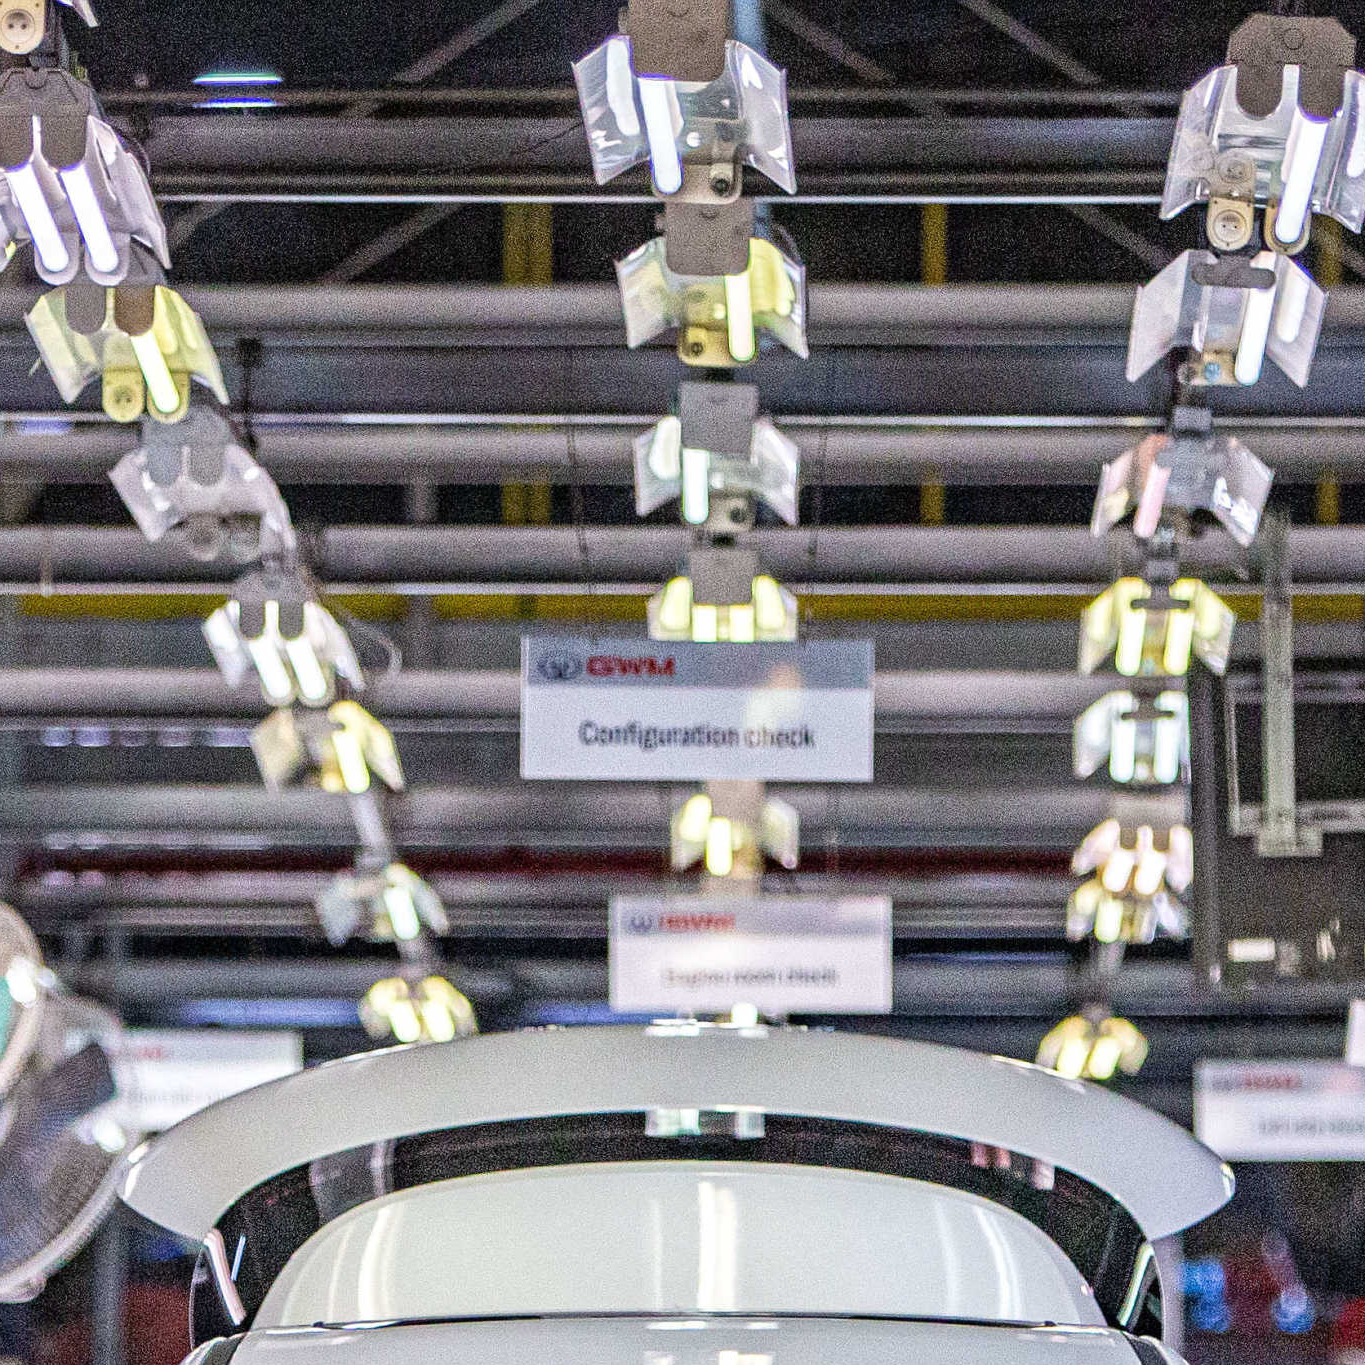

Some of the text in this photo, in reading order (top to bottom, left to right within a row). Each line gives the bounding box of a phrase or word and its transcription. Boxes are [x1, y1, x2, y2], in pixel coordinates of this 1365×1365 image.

[586, 656, 675, 677] GWM
[579, 721, 815, 750] Configuration check
